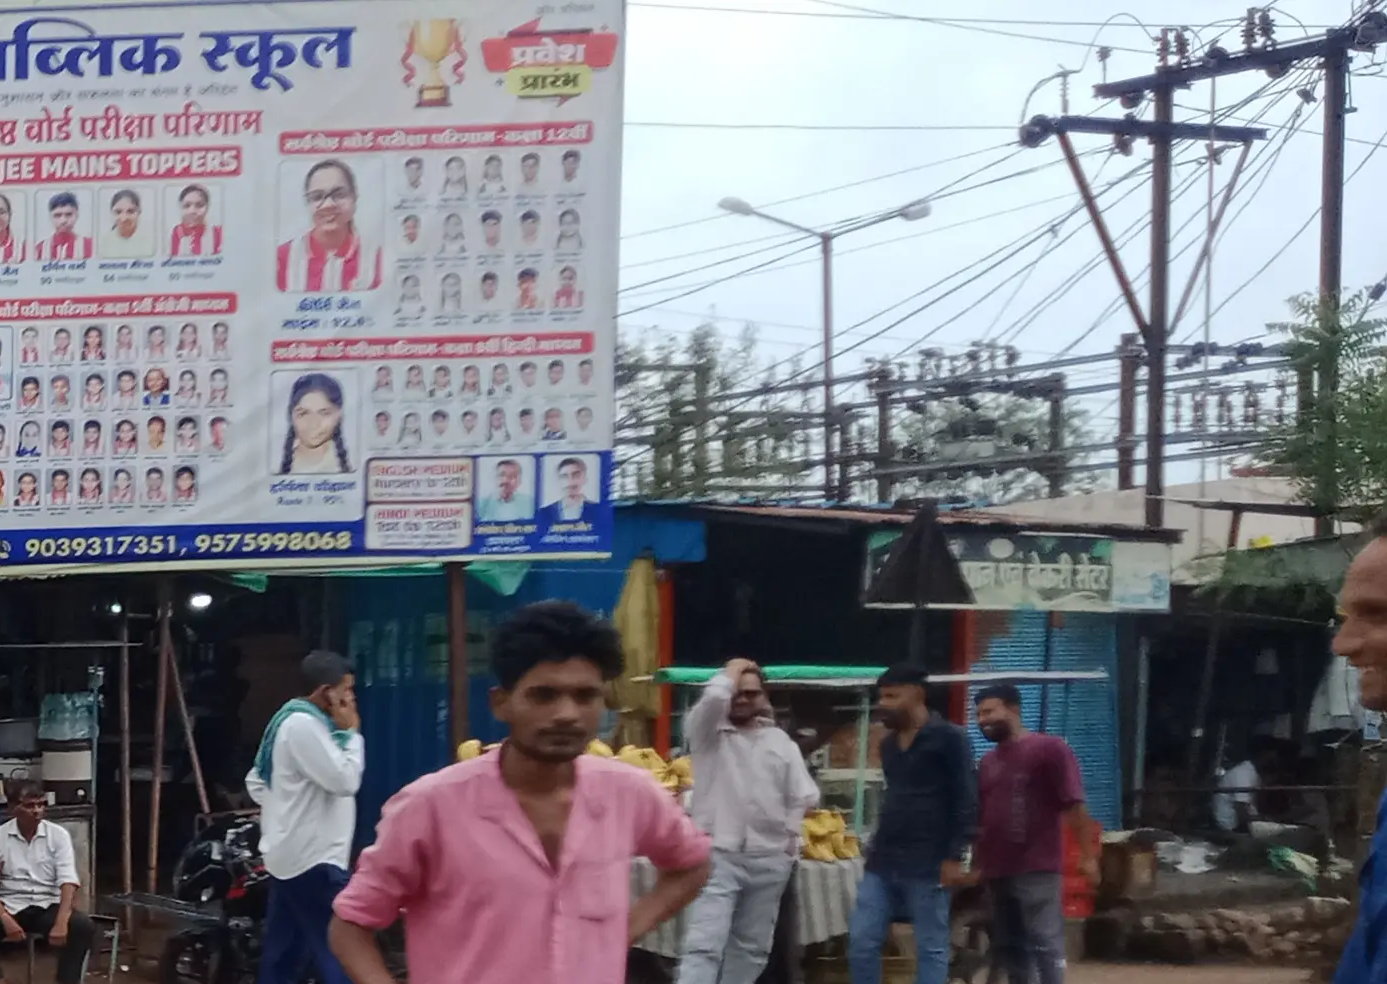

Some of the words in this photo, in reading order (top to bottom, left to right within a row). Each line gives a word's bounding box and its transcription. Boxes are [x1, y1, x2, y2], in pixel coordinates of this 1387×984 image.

[199, 26, 357, 92] स्कूल
[511, 37, 587, 67] प्रवेश
[519, 66, 581, 92] प्रारंभ
[24, 105, 74, 144] बोर्ड
[79, 103, 156, 142] परीक्षा
[163, 100, 265, 138] परिणाम
[40, 153, 122, 179] MAINS
[127, 149, 240, 177] TOPPERS
[24, 535, 187, 558] 9039317351,
[193, 529, 354, 555] 9575998068
